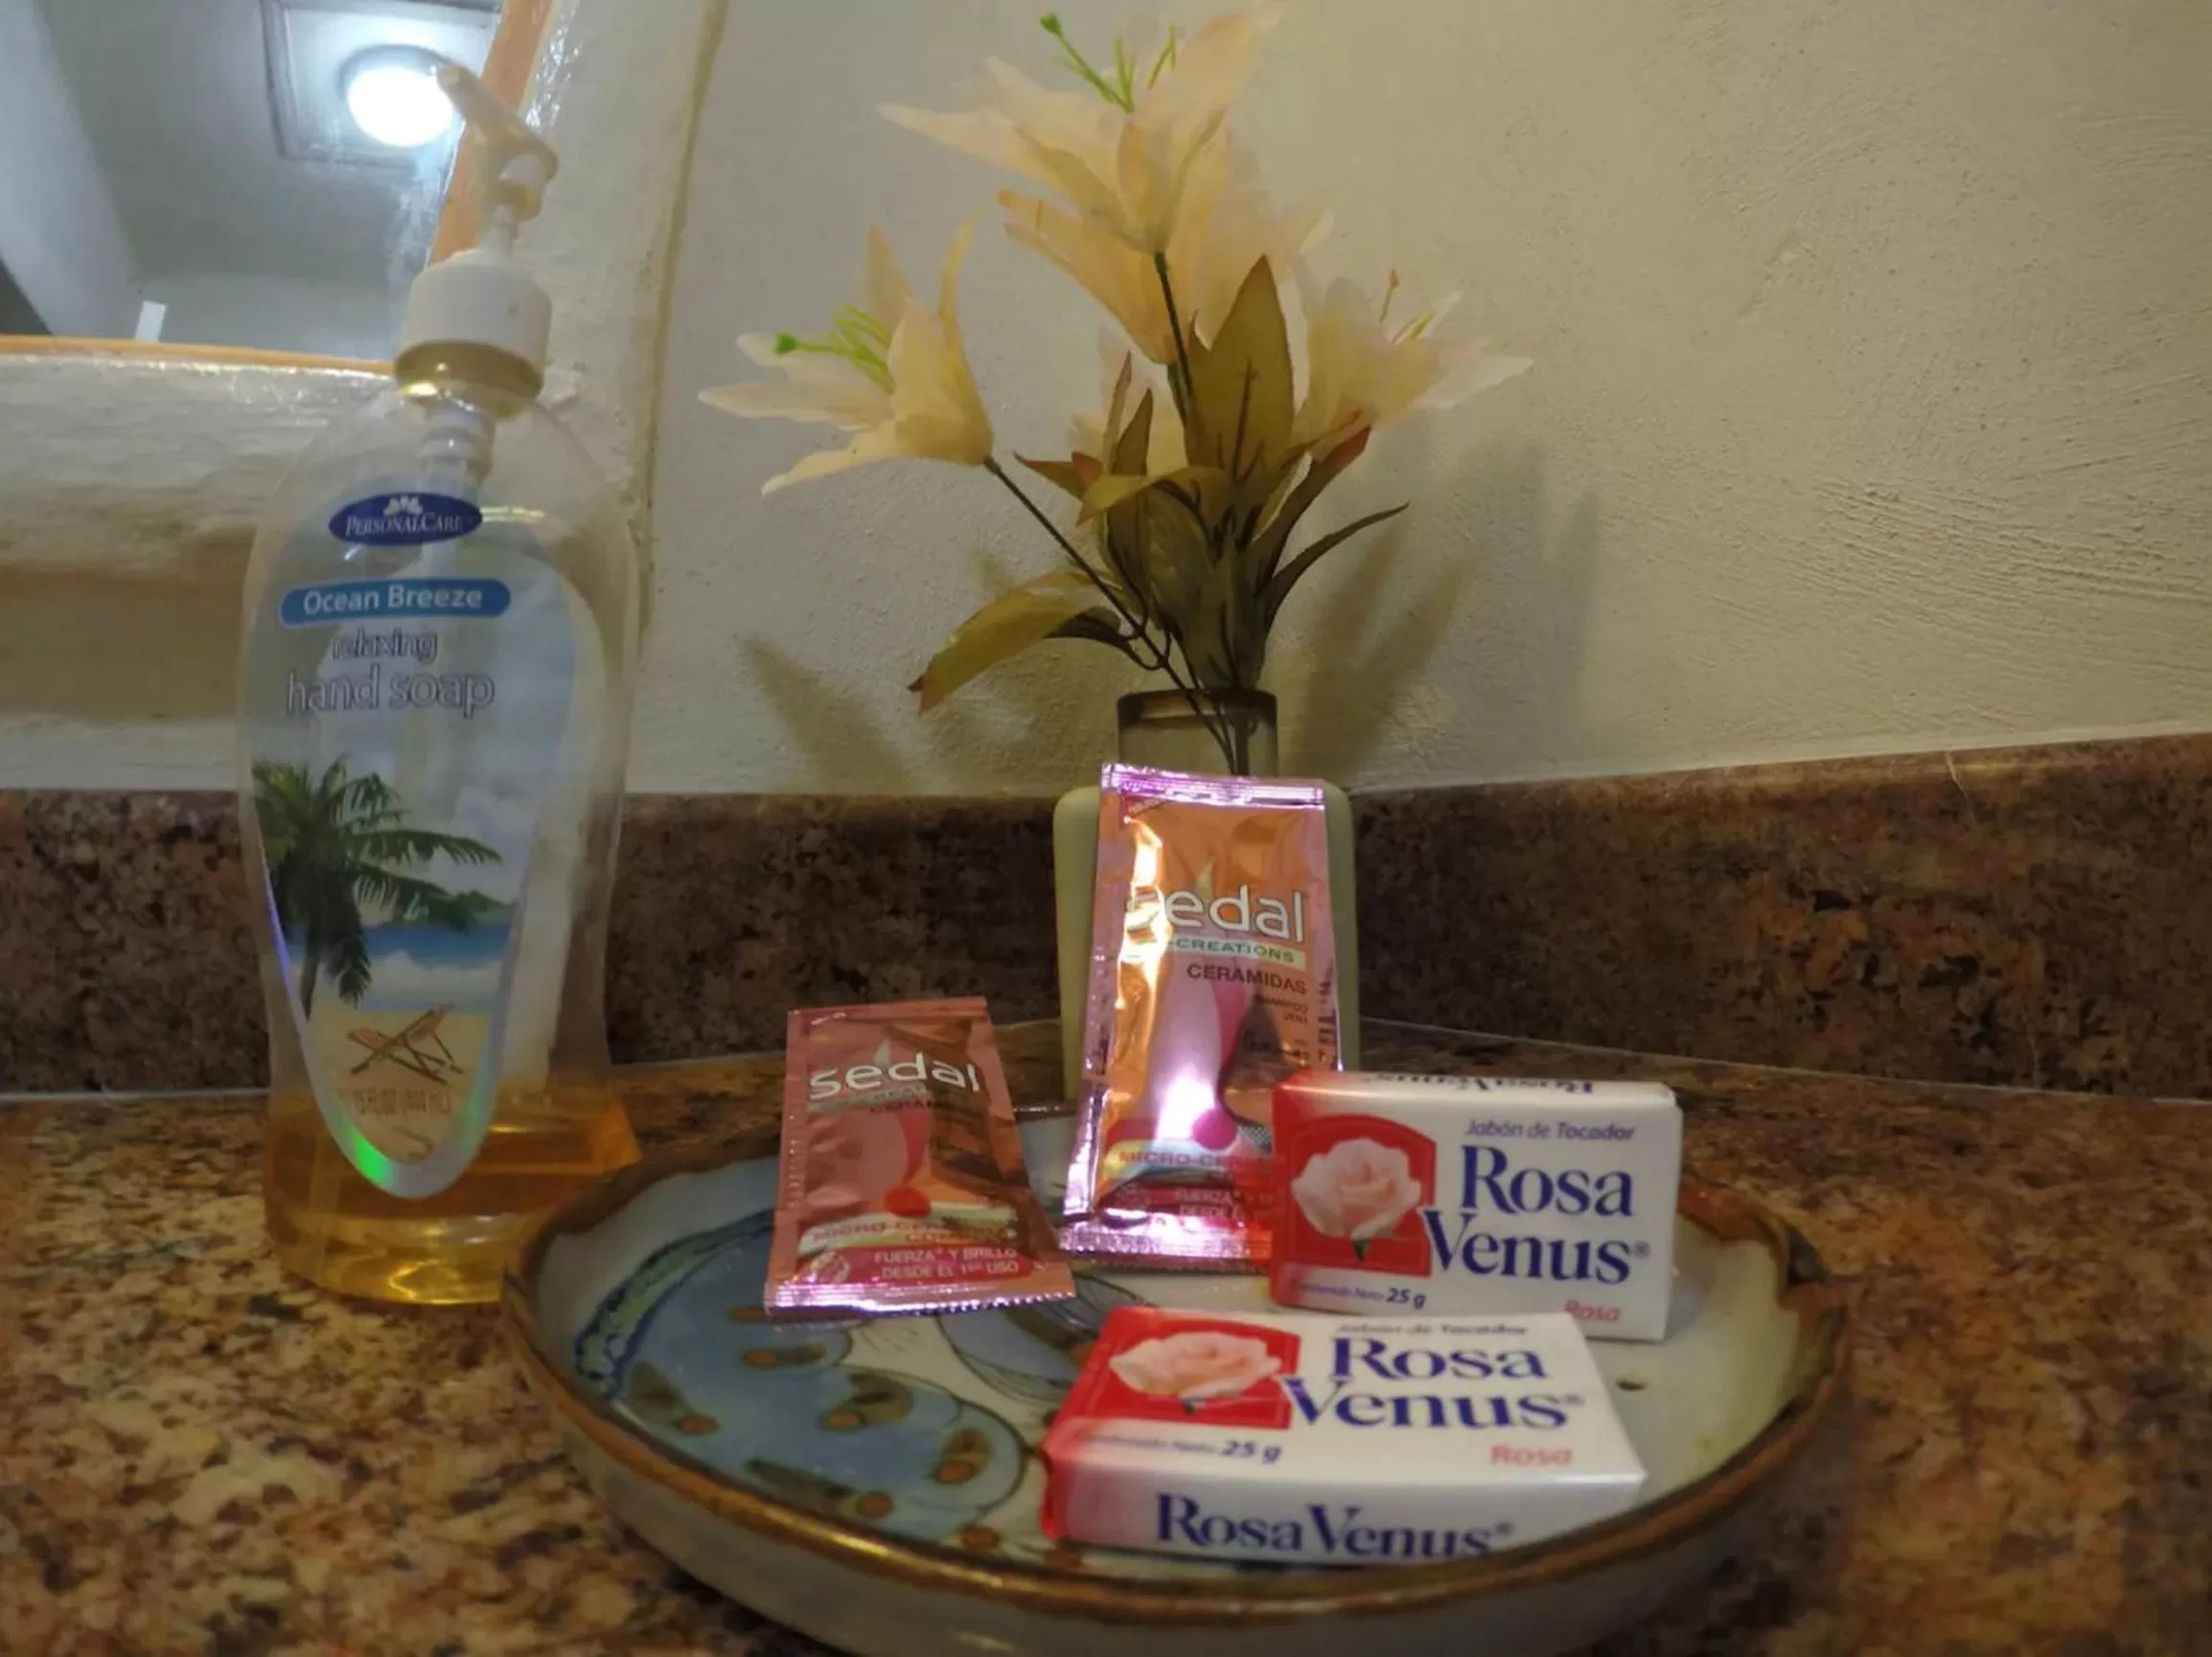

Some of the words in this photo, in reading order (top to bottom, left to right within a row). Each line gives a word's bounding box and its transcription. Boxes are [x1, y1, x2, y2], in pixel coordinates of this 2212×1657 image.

[303, 589, 380, 615] Ocean
[387, 584, 484, 610] Breeze
[286, 662, 381, 716] hand
[387, 672, 496, 720] soap
[1176, 937, 1295, 964] CREATIONS
[1187, 962, 1306, 996] CERAMIDAS
[809, 1050, 980, 1101] sedal
[1527, 1119, 1551, 1140] de
[1557, 1119, 1636, 1141] Tocador
[1462, 1144, 1634, 1216] Rosa
[986, 1260, 1020, 1275] USO
[1387, 1287, 1412, 1304] 25
[1563, 1299, 1622, 1322] Rosa
[1331, 1337, 1549, 1380] Rosa
[1222, 1438, 1257, 1458] 25
[1490, 1443, 1573, 1467] Rosa
